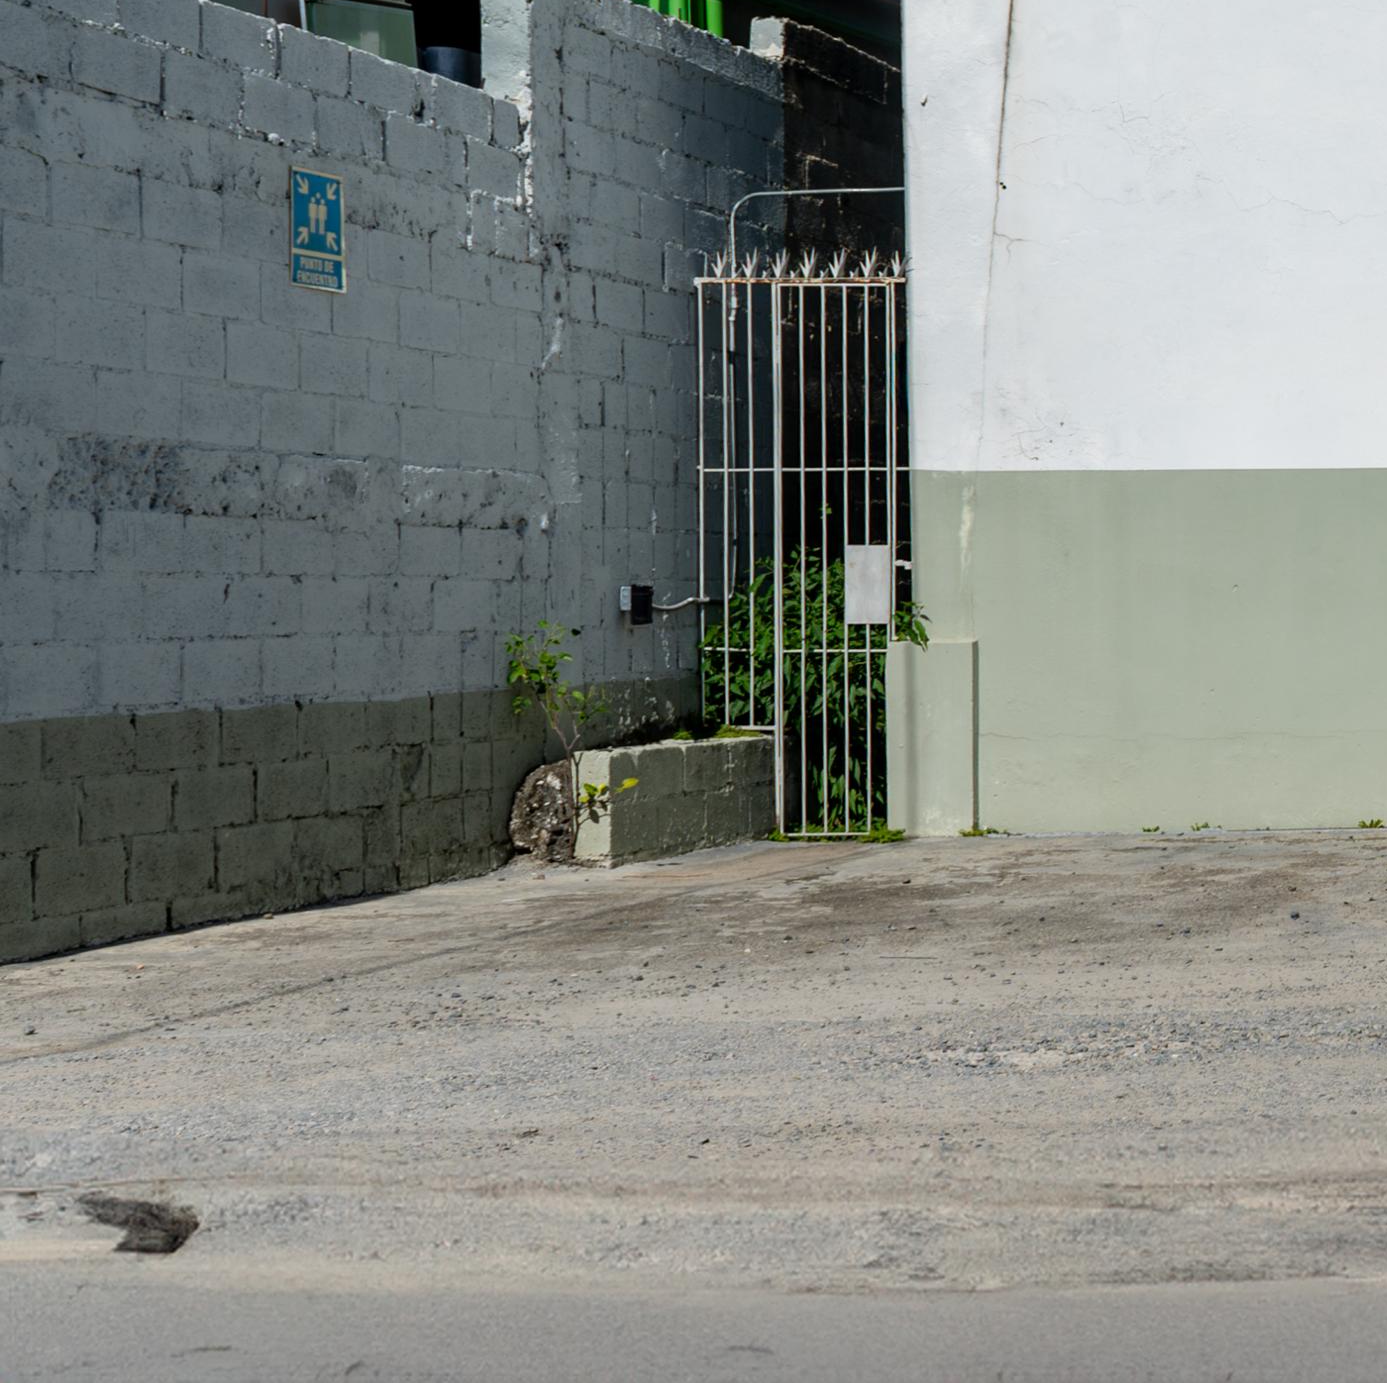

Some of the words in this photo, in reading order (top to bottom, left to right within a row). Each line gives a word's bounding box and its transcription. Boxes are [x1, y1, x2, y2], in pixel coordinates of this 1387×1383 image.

[300, 257, 323, 272] PUNTO
[324, 260, 334, 274] DE
[297, 270, 338, 287] ENCUENTRO
